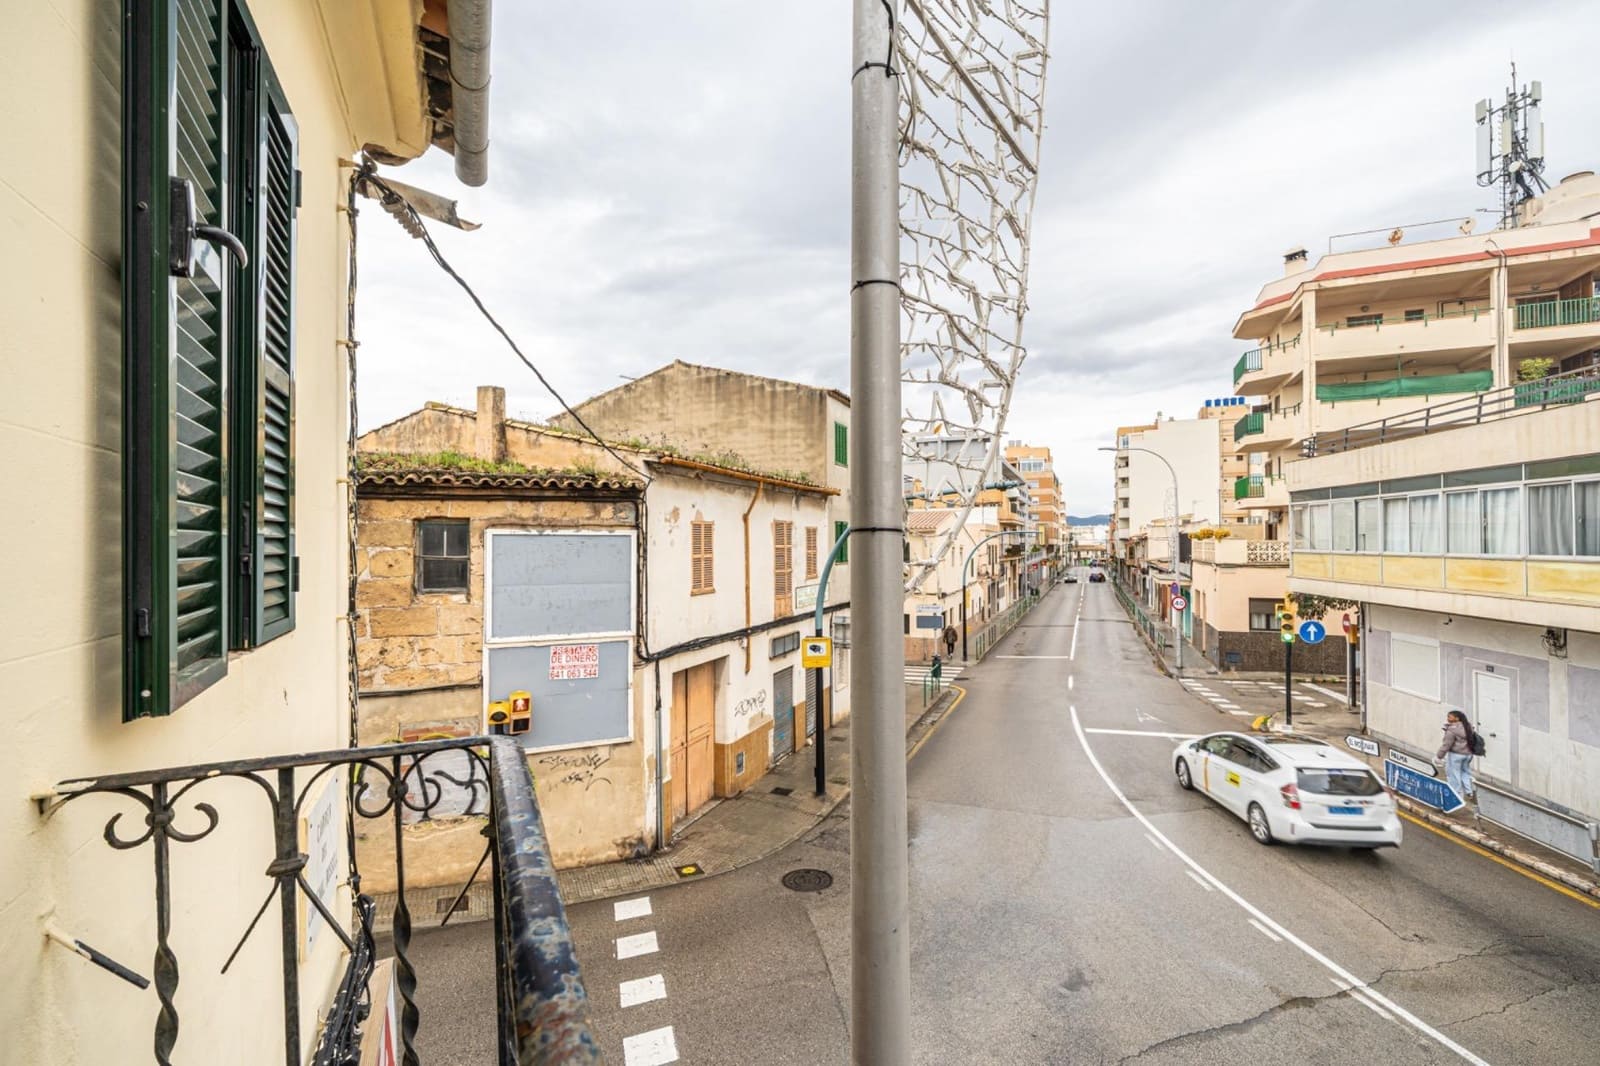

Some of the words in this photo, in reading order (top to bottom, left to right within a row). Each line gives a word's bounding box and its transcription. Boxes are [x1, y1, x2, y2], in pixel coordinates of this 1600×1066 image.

[551, 655, 563, 664] DE
[565, 653, 598, 663] DINERO
[1390, 751, 1409, 763] PALMA
